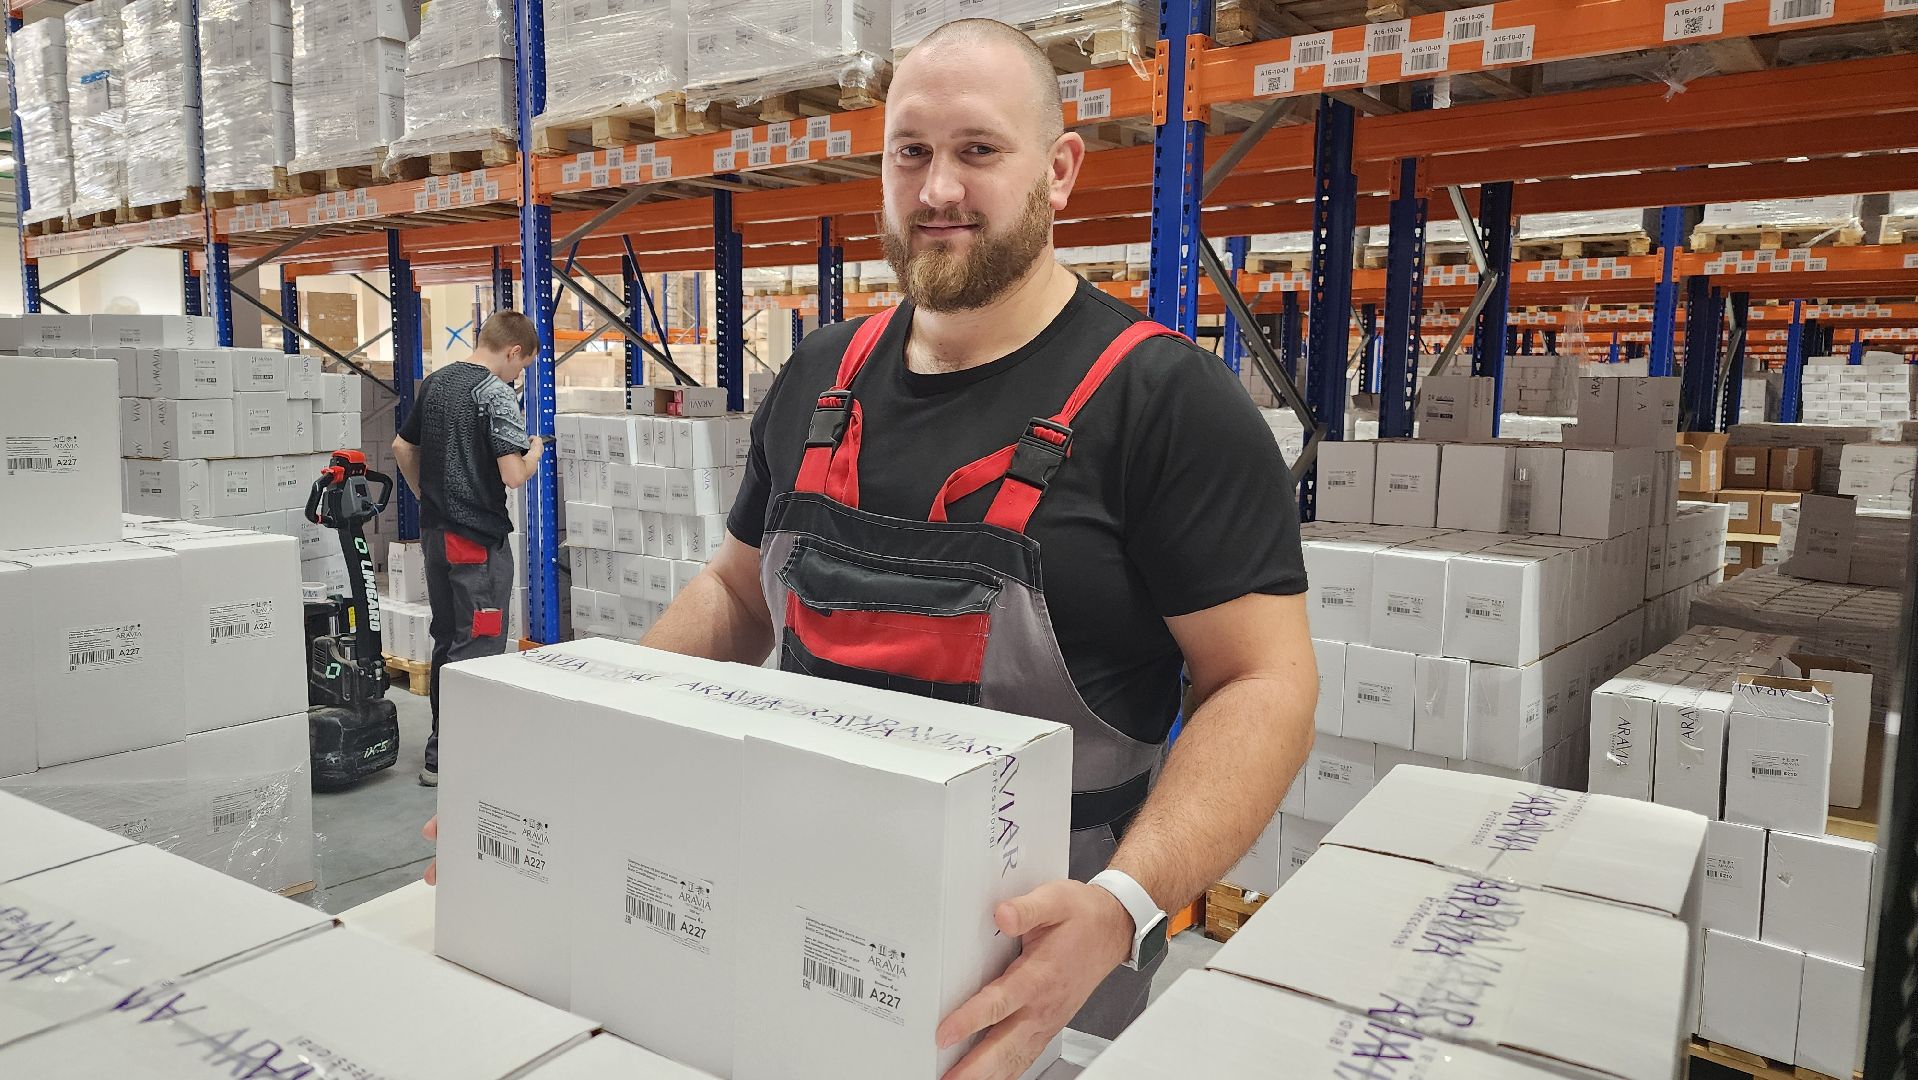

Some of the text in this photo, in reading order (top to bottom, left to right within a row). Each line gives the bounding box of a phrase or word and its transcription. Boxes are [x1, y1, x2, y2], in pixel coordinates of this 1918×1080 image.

[1673, 4, 1715, 17] A16-11-01
[1298, 38, 1326, 48] A16-10-02
[1493, 33, 1526, 43] A16-10-07
[1260, 68, 1289, 76] A16-10-01
[57, 458, 77, 466] A227
[254, 621, 272, 630] A227
[116, 630, 142, 639] ARAVIA
[119, 647, 140, 656] A227
[522, 828, 550, 845] ARAVIA
[523, 855, 546, 871] A227
[679, 891, 711, 911] ARAVIA
[680, 921, 706, 940] A227
[868, 955, 907, 977] ARAVIA
[869, 988, 901, 1010] A227
